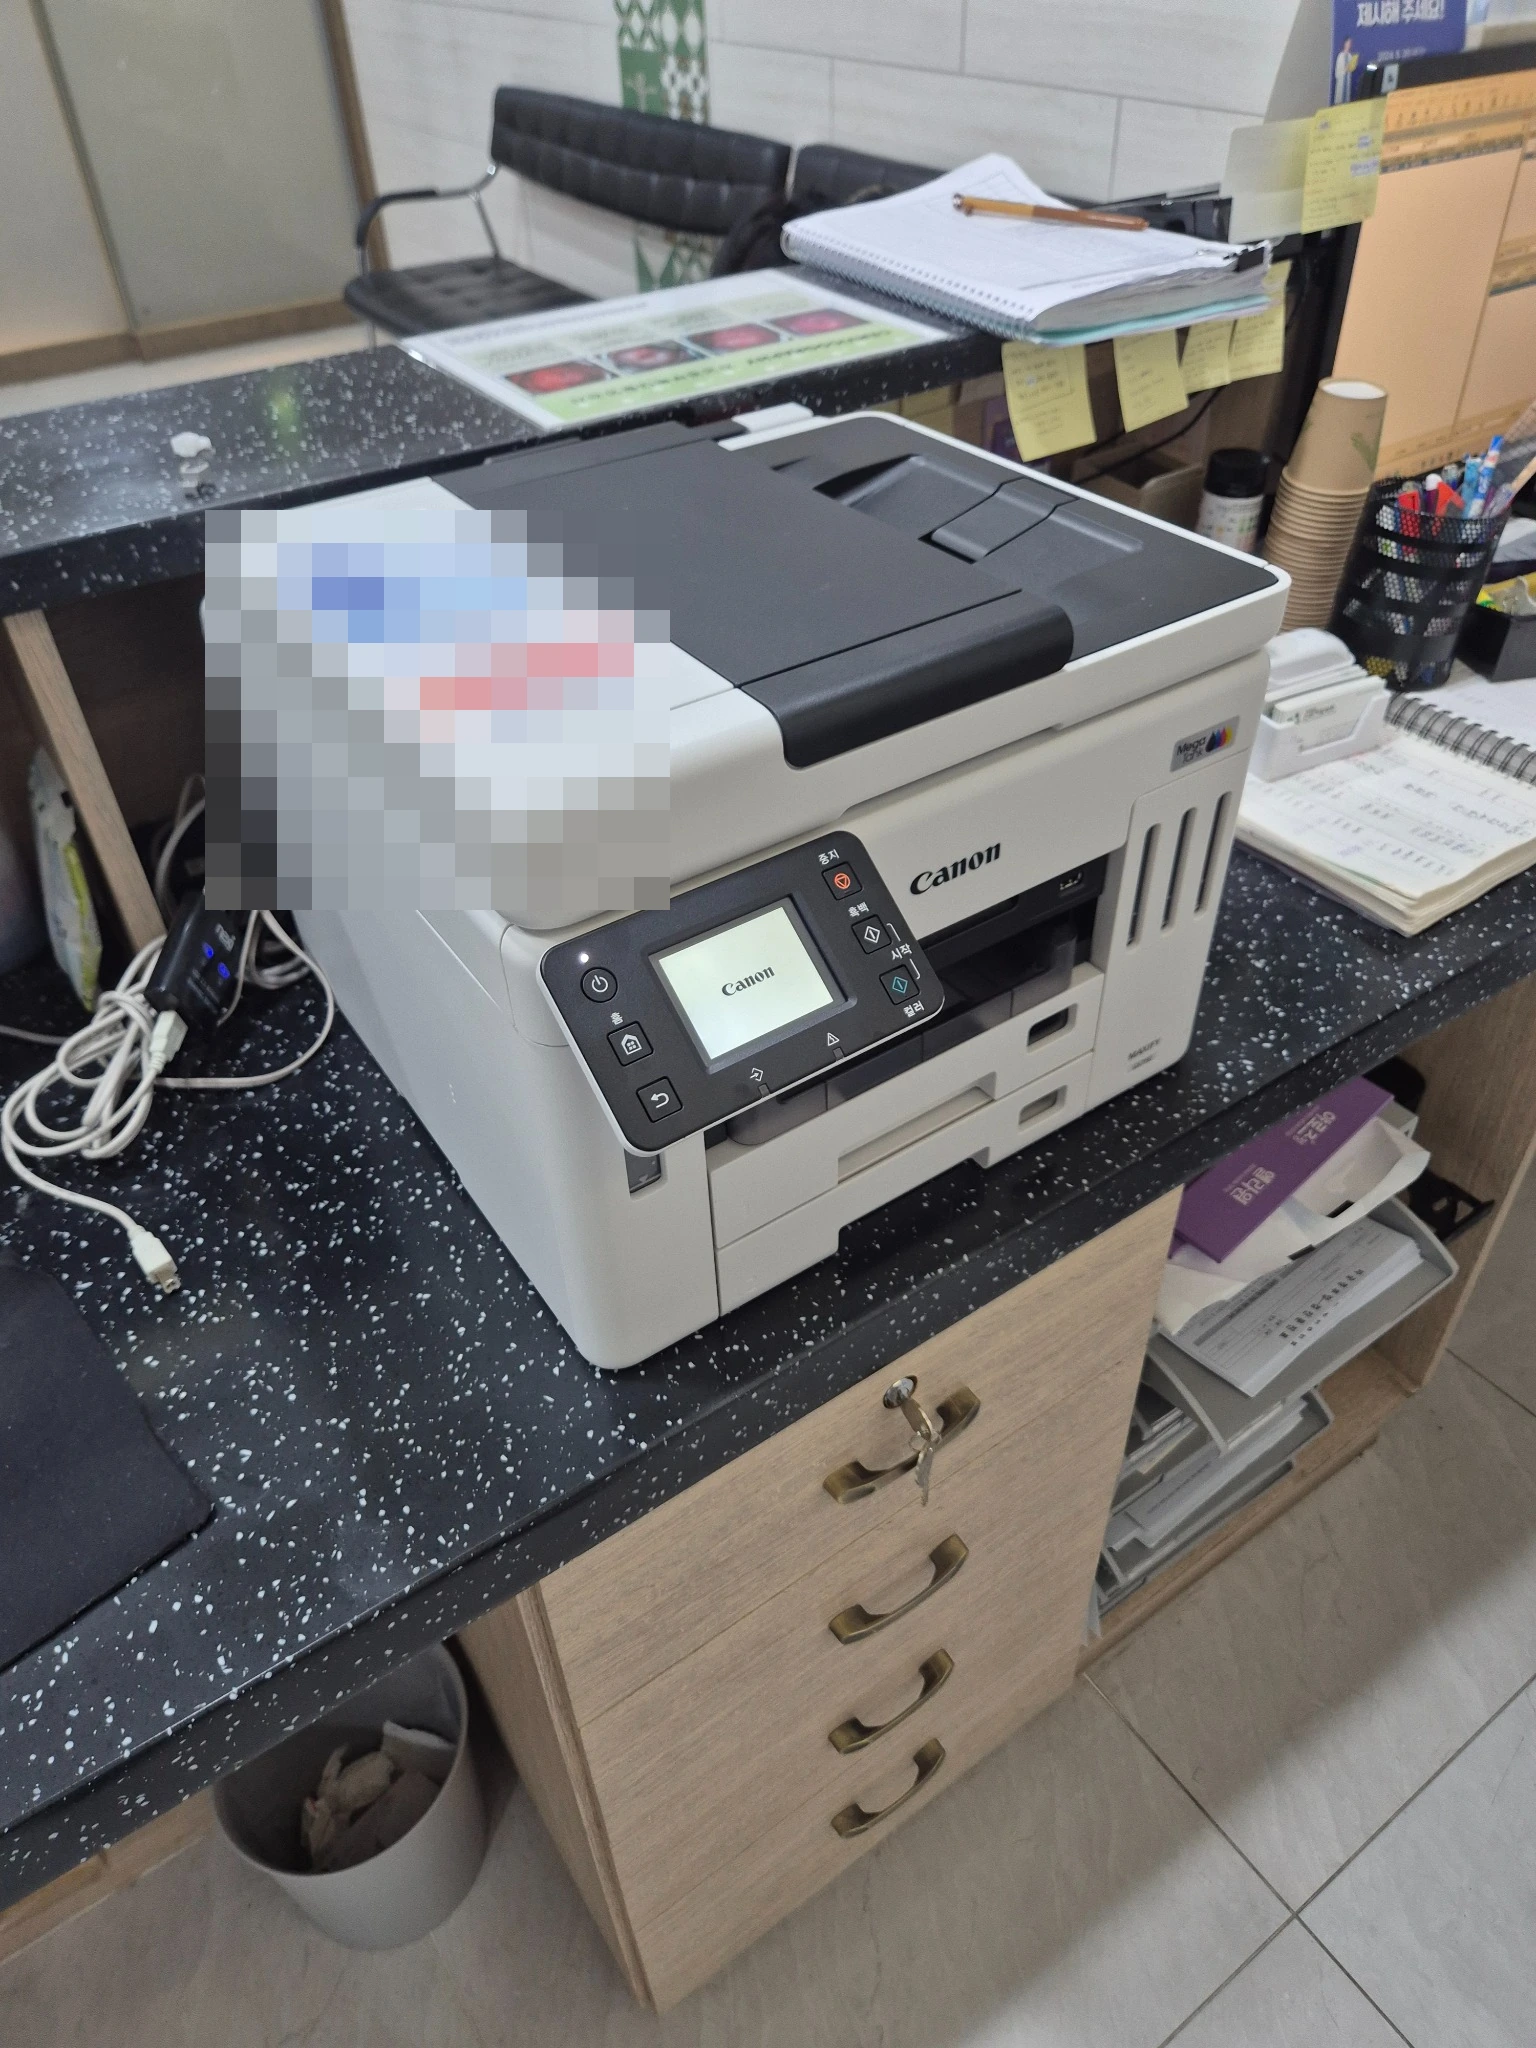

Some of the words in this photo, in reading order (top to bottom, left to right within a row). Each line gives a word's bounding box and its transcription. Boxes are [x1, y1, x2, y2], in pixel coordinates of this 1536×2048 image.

[1176, 736, 1207, 757] Mega
[817, 847, 840, 866] 중지
[909, 841, 1003, 896] Canon
[847, 901, 870, 919] 흑백
[890, 942, 913, 961] 시작
[720, 963, 776, 998] Canon
[903, 999, 925, 1018] 컬러
[610, 1011, 624, 1026] 홈
